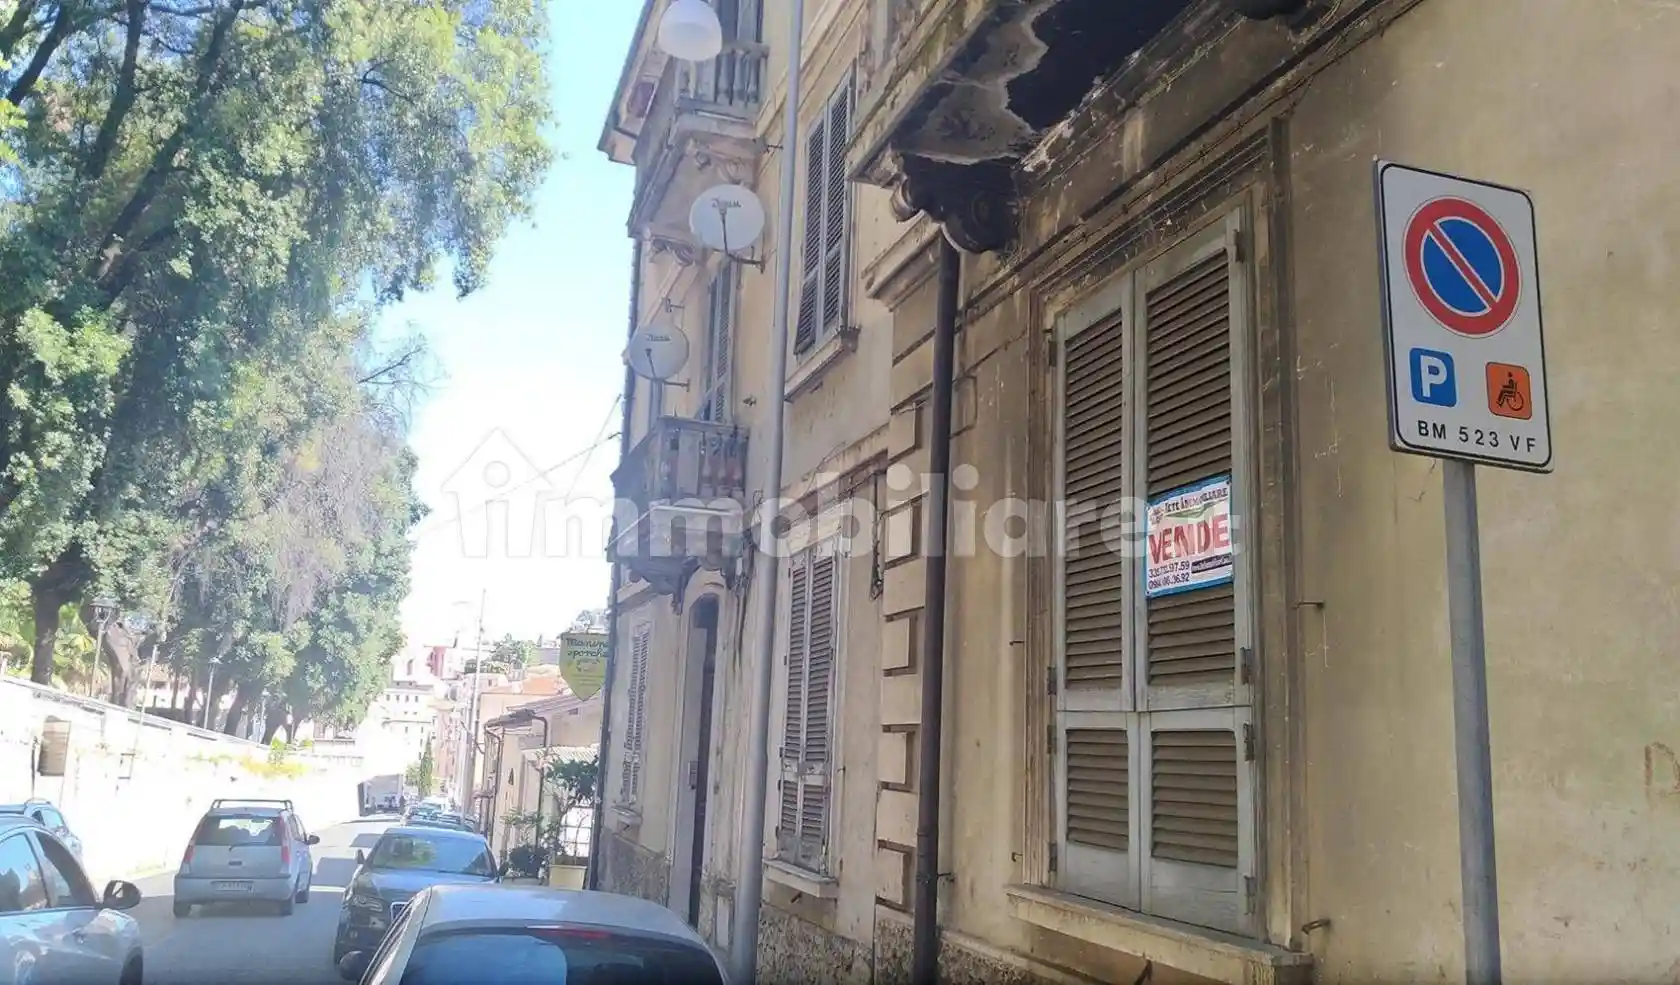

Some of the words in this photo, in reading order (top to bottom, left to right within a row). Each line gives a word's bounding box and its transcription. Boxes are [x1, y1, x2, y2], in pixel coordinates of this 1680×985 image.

[1419, 354, 1448, 398] P
[1417, 419, 1447, 440] BM
[1458, 425, 1500, 448] 523
[1148, 512, 1230, 565] VENDE
